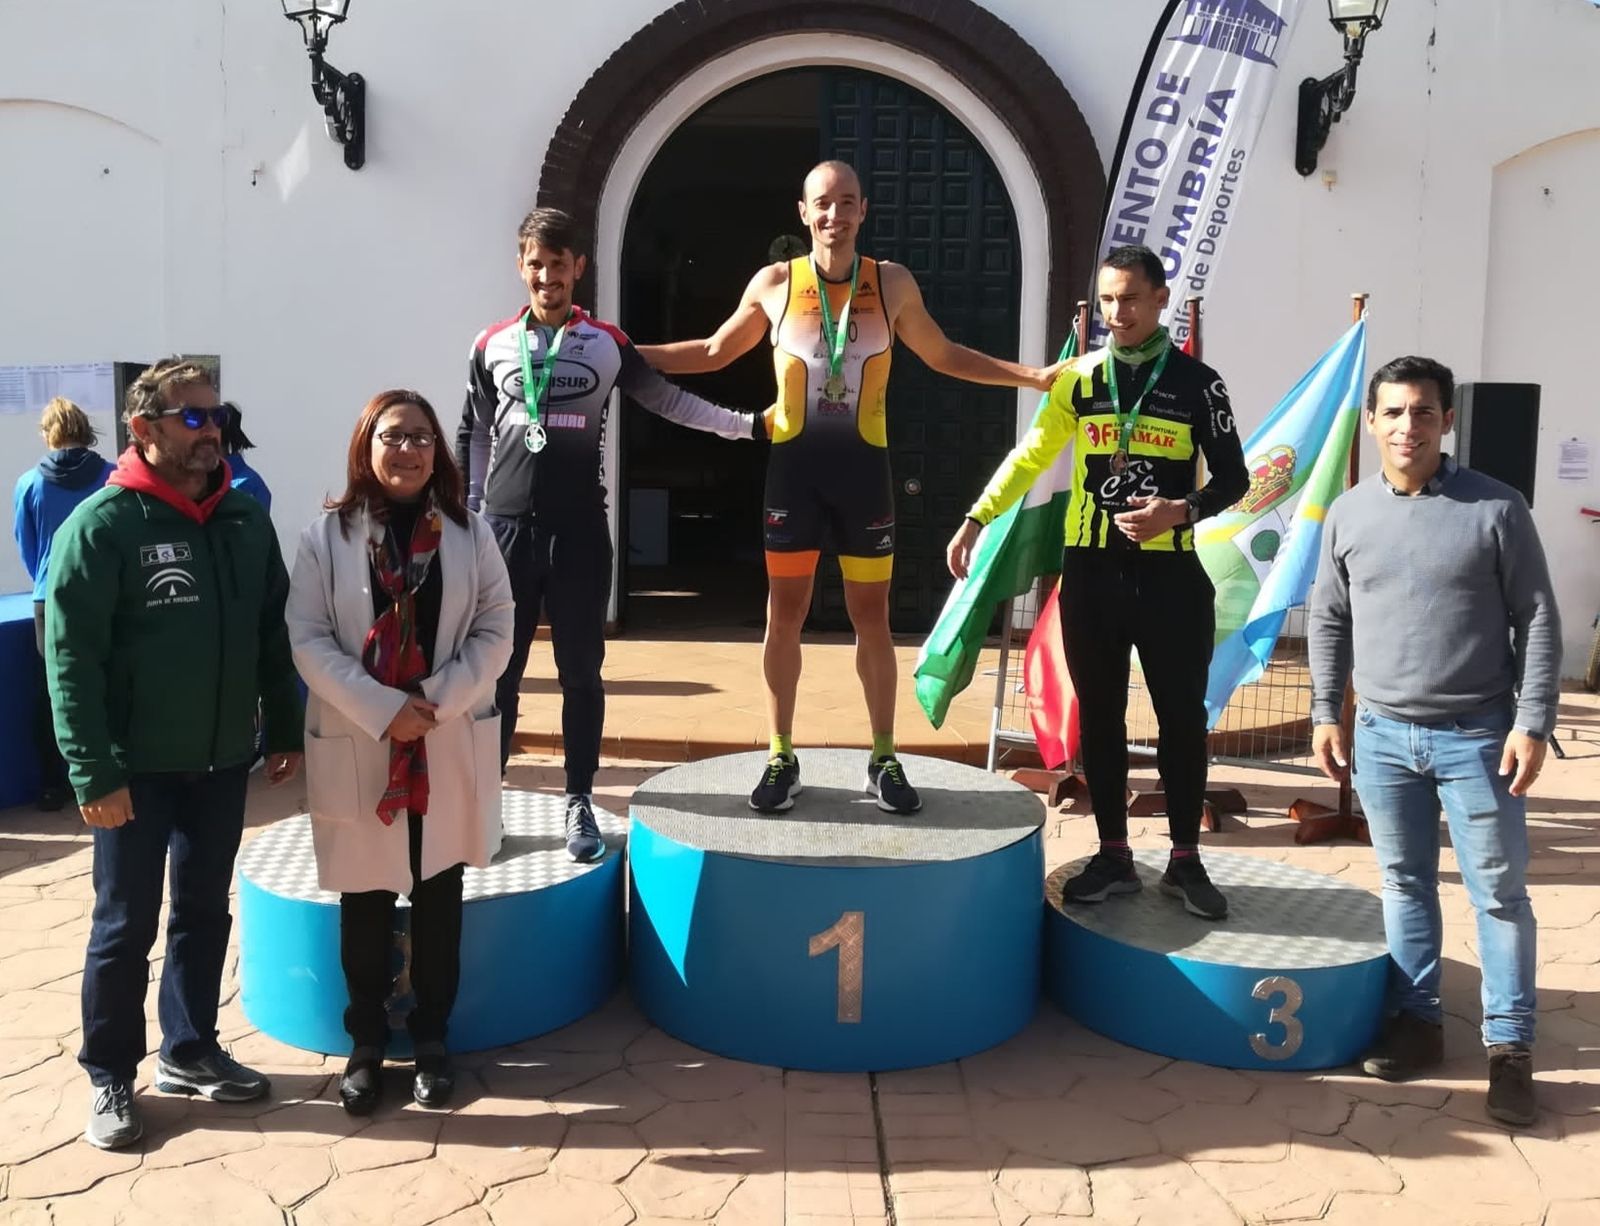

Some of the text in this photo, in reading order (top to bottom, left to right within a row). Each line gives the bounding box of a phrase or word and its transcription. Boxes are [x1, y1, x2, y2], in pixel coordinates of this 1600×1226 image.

[1146, 72, 1190, 125] DE
[1160, 89, 1236, 281] UMBRÍA
[1195, 148, 1245, 256] Deportes
[1187, 262, 1210, 291] de
[808, 910, 866, 1024] 1
[1250, 976, 1304, 1061] 3
